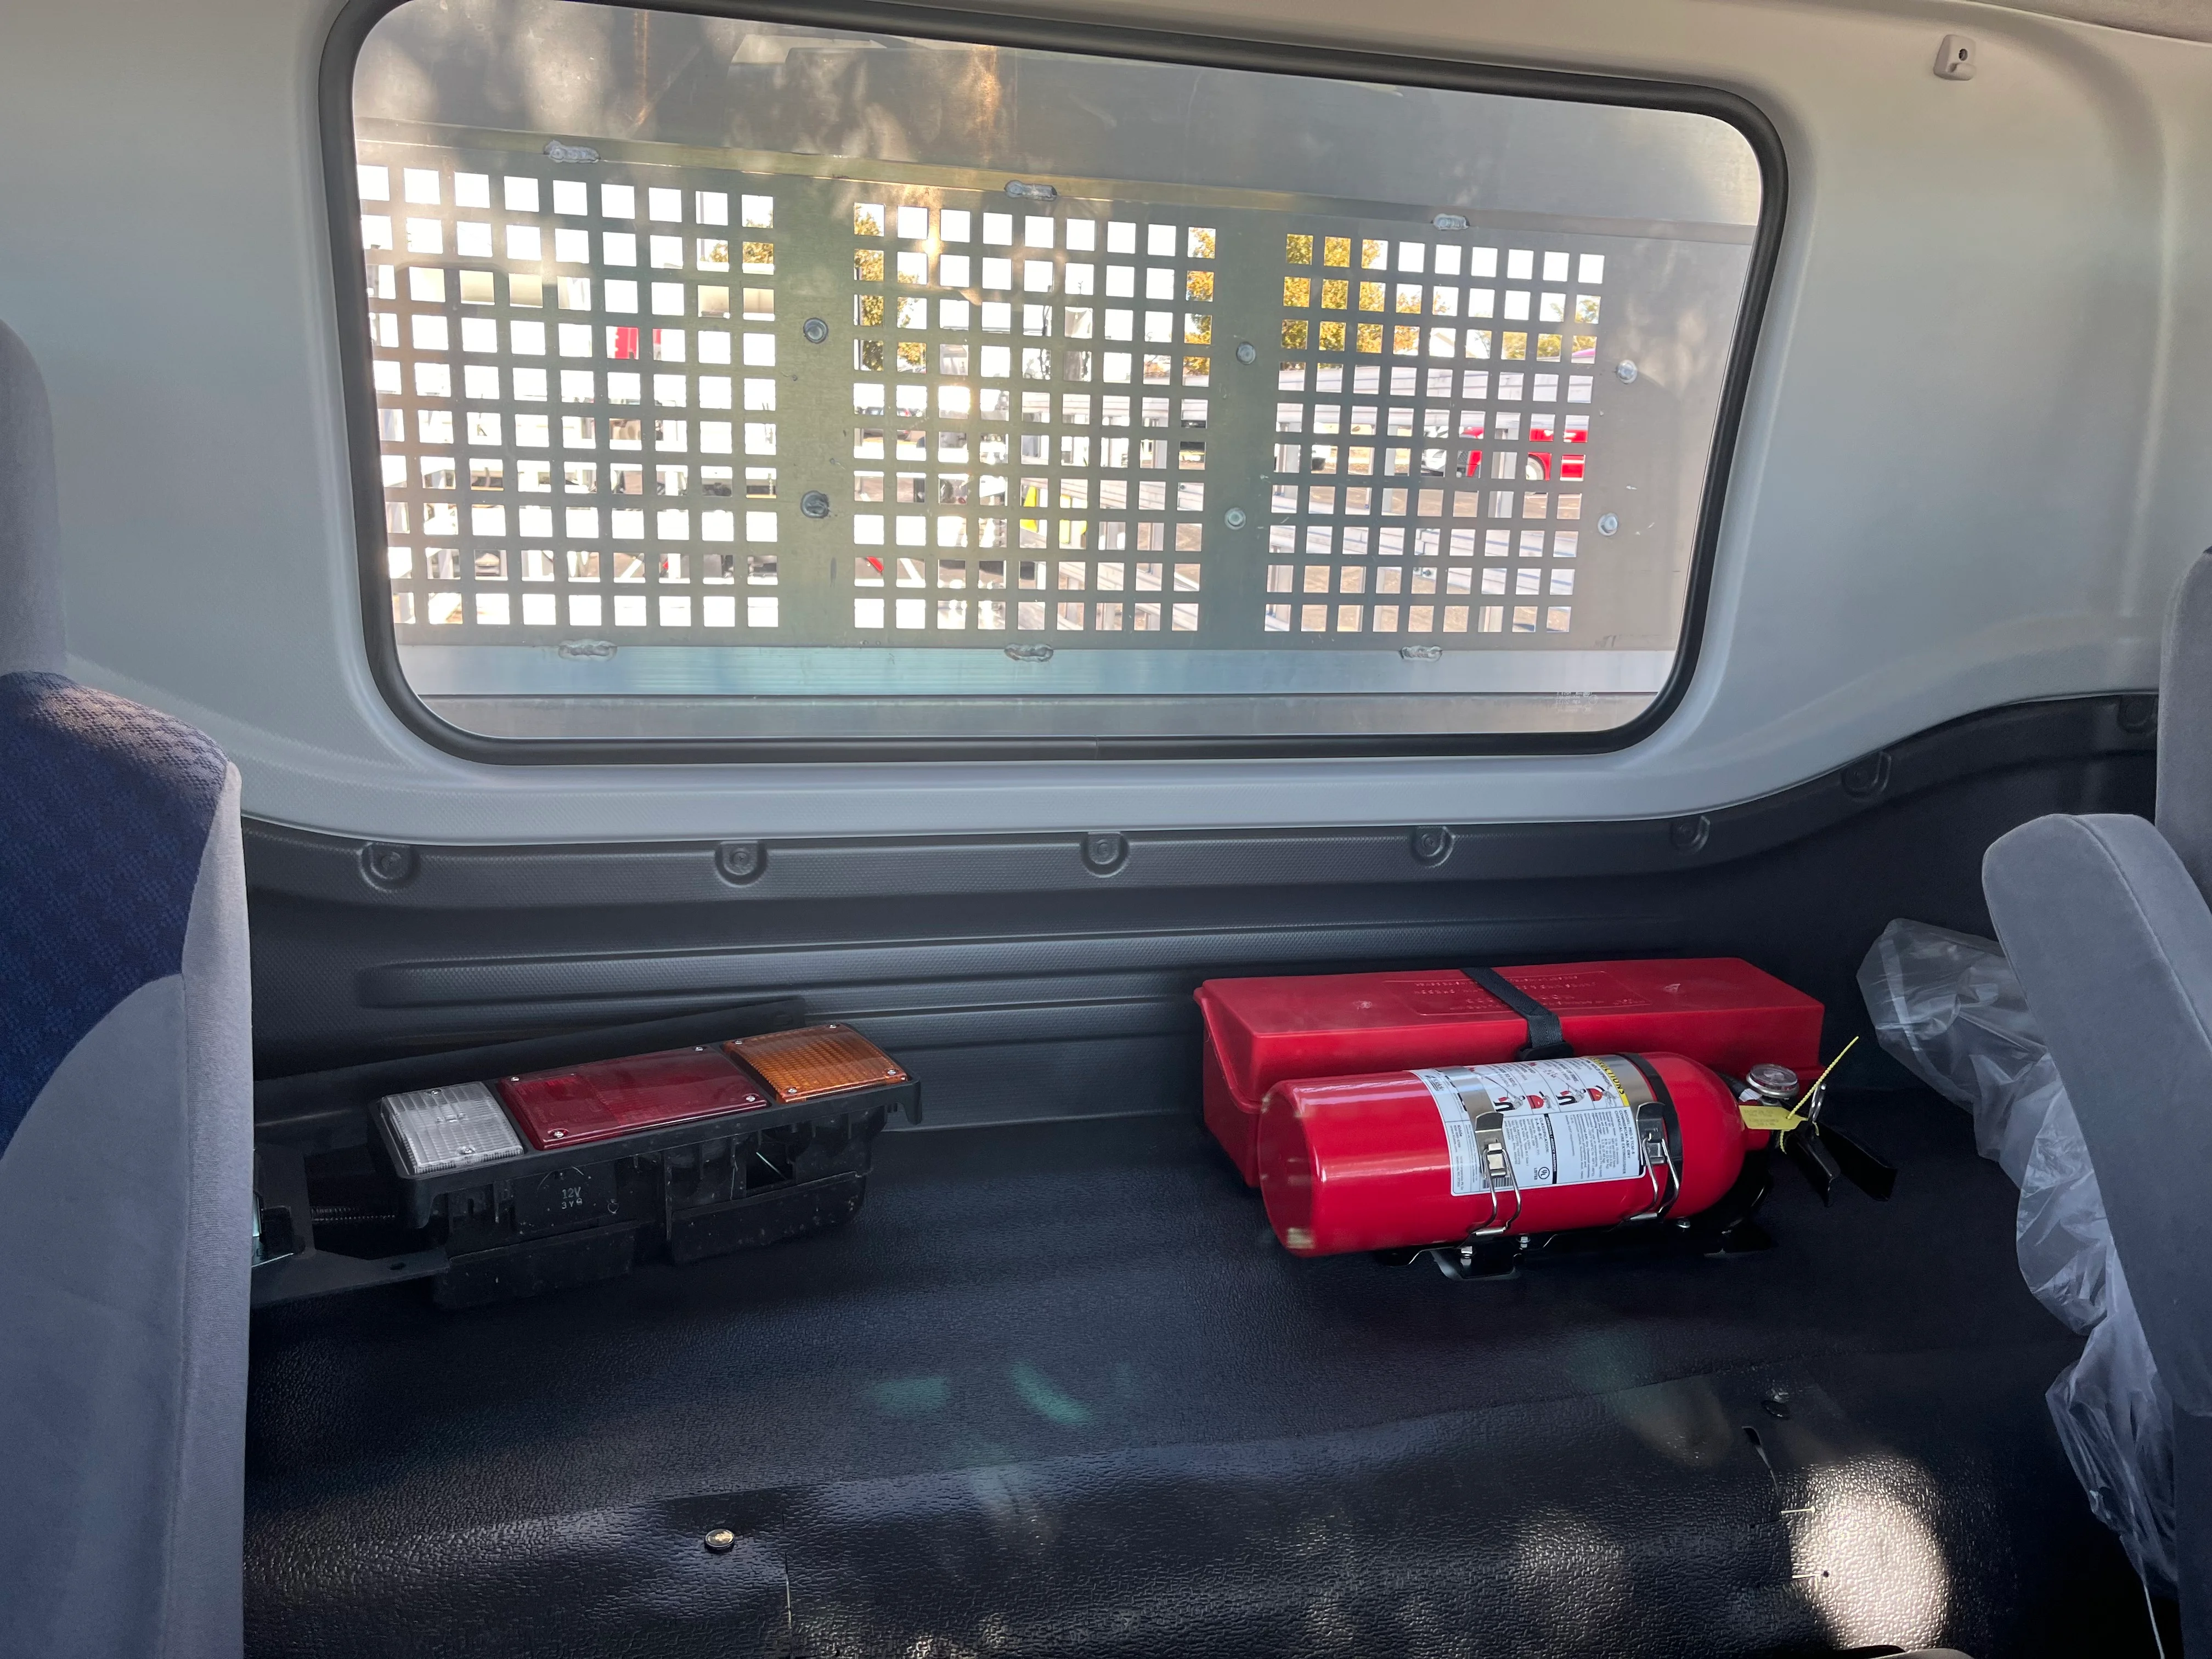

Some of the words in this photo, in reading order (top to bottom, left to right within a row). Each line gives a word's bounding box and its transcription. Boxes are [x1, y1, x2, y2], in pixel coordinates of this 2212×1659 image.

[1539, 1118, 1549, 1154] CLASSIFICATION:
[1619, 1110, 1628, 1138] COMMERCIAL
[562, 1187, 582, 1199] 12V
